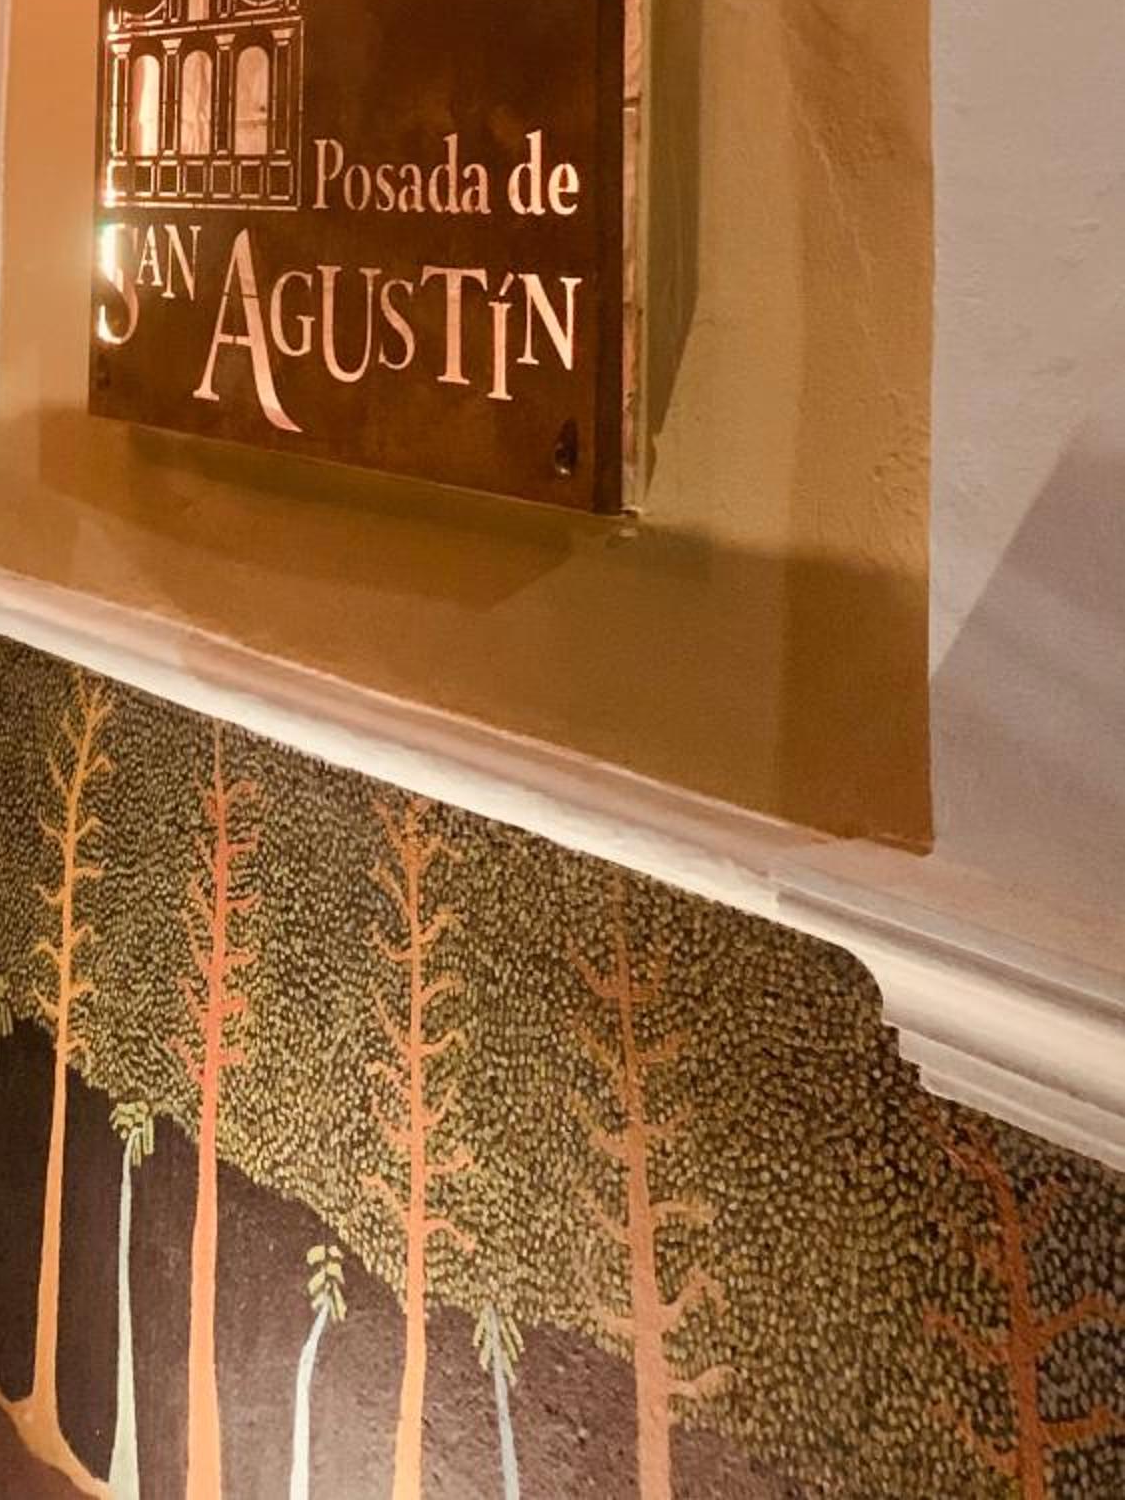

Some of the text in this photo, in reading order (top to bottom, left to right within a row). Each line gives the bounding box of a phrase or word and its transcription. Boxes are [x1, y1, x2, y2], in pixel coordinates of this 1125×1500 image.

[312, 129, 580, 216] Posada de
[97, 223, 202, 345] SAN
